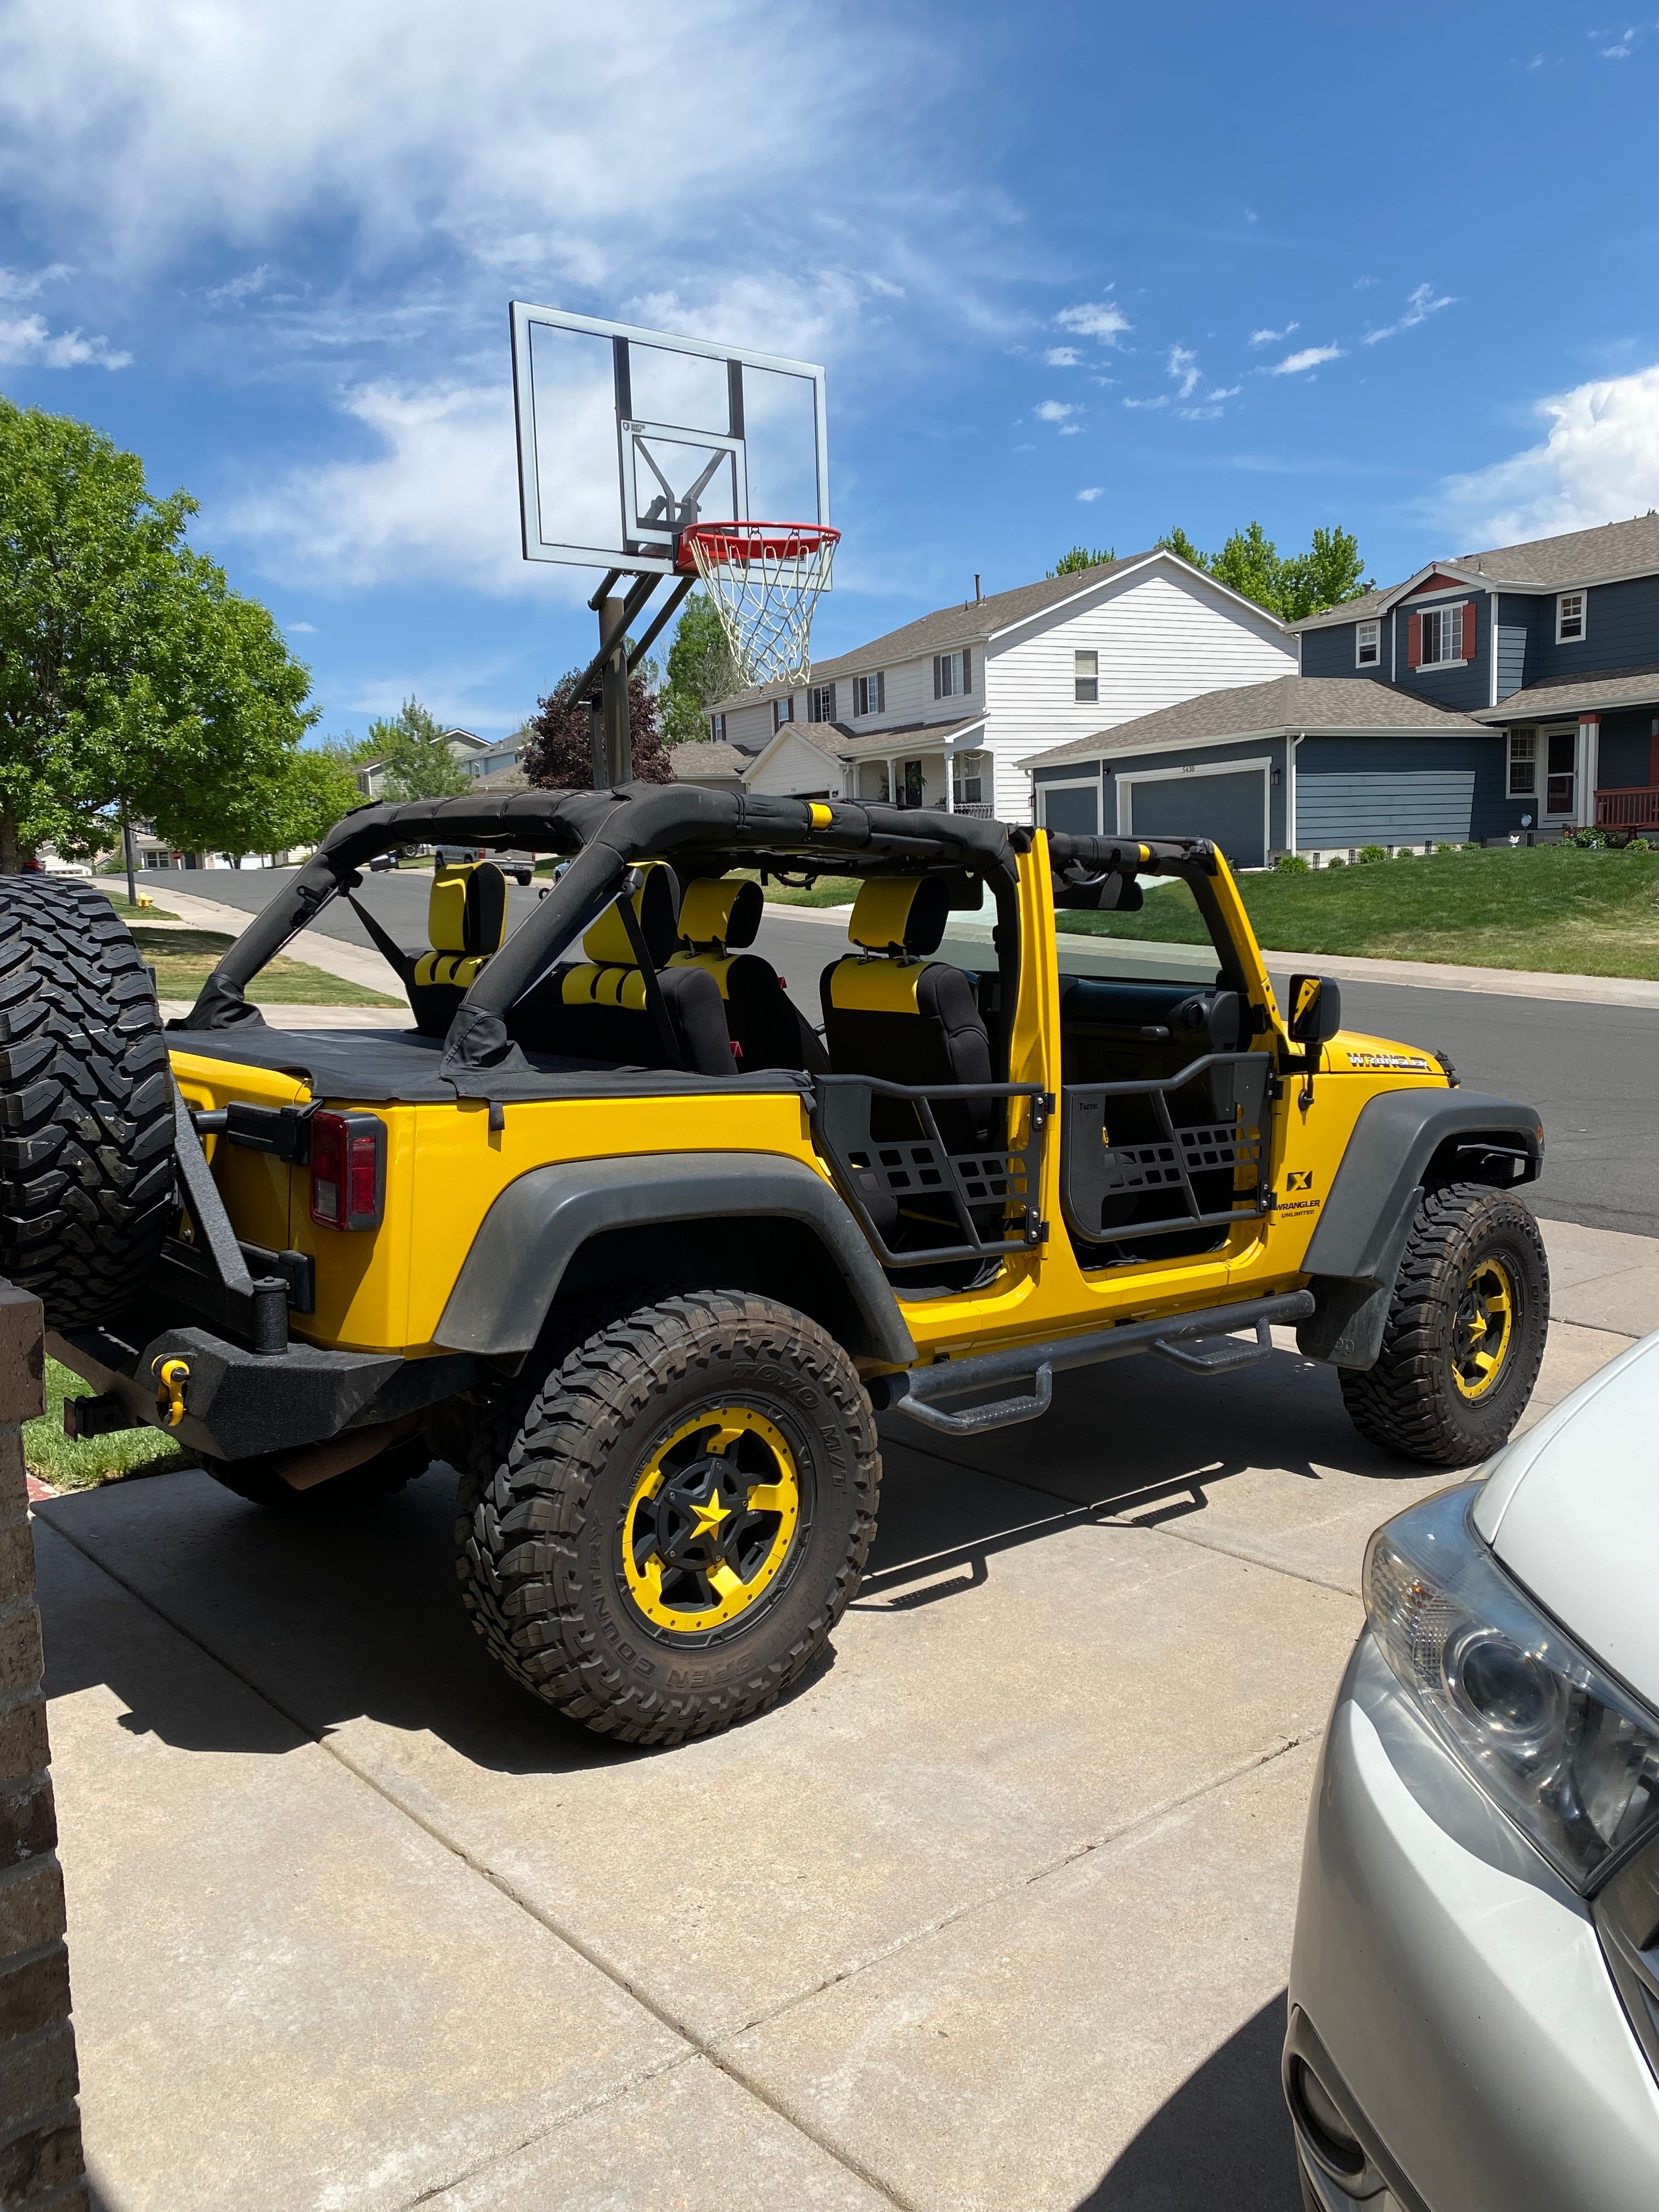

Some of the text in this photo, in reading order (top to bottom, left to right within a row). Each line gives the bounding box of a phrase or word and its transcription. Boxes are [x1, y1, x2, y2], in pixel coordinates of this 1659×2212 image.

[1346, 1052, 1433, 1071] WRANGLER
[1281, 1209, 1315, 1218] UNLIMITED
[1310, 1330, 1356, 1357] Jeep
[731, 1362, 820, 1408] TOYO
[820, 1423, 848, 1494] M/T
[589, 1510, 758, 1688] OPEN COUNTRY
